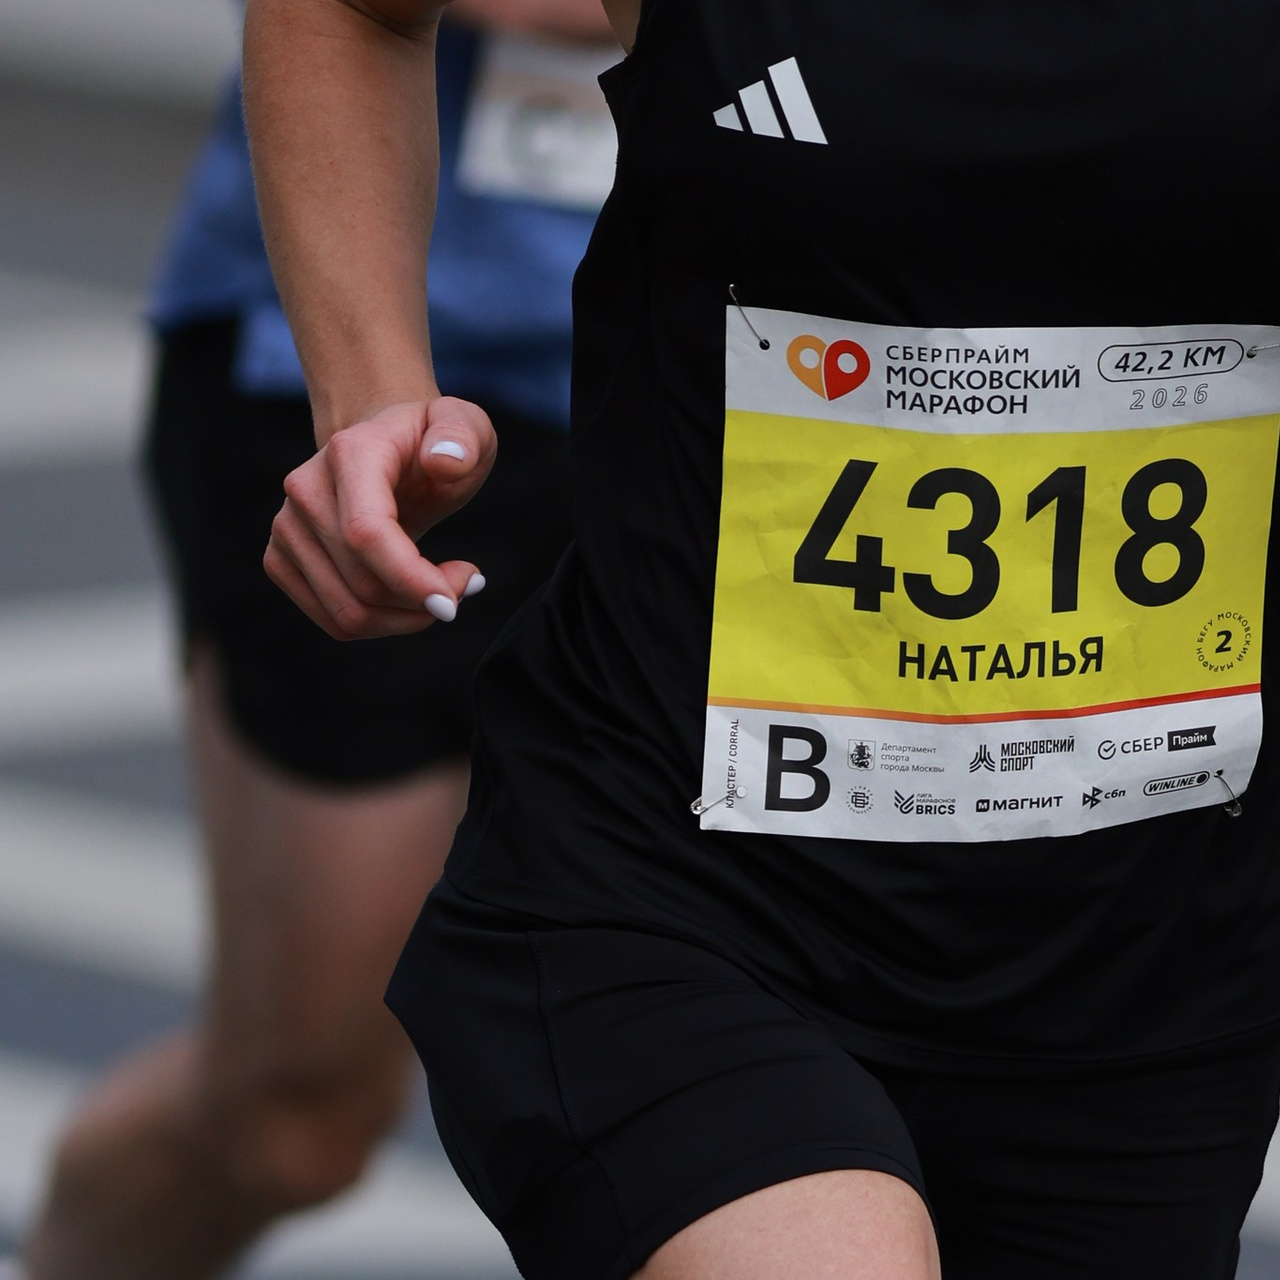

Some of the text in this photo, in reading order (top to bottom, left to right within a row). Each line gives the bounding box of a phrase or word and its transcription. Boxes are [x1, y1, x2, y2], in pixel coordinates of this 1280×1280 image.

[886, 345, 1029, 364] СБЕРПРАЙМ
[1115, 350, 1172, 375] 42,2
[886, 365, 1080, 390] МОСКОВСКИЙ
[886, 390, 1028, 415] МАРАФОН
[1130, 384, 1209, 410] 2026
[793, 458, 1208, 621] 4318
[1197, 620, 1212, 643] БЕГУ
[1215, 630, 1232, 653] 2
[898, 636, 1104, 682] НАТАЛЬЯ
[729, 719, 739, 757] CORRAL
[881, 743, 937, 754] Департамент
[1001, 735, 1075, 756] МОСКОВСКИЙ
[1121, 733, 1207, 754] СБЕР Прайм
[880, 764, 944, 772] города Москвы
[881, 754, 909, 762] спорта
[1001, 756, 1034, 772] СПОРТ
[1104, 789, 1126, 799] сбп
[1149, 777, 1196, 792] WINLINE
[916, 803, 955, 815] BRICS
[993, 796, 1063, 811] магнит
